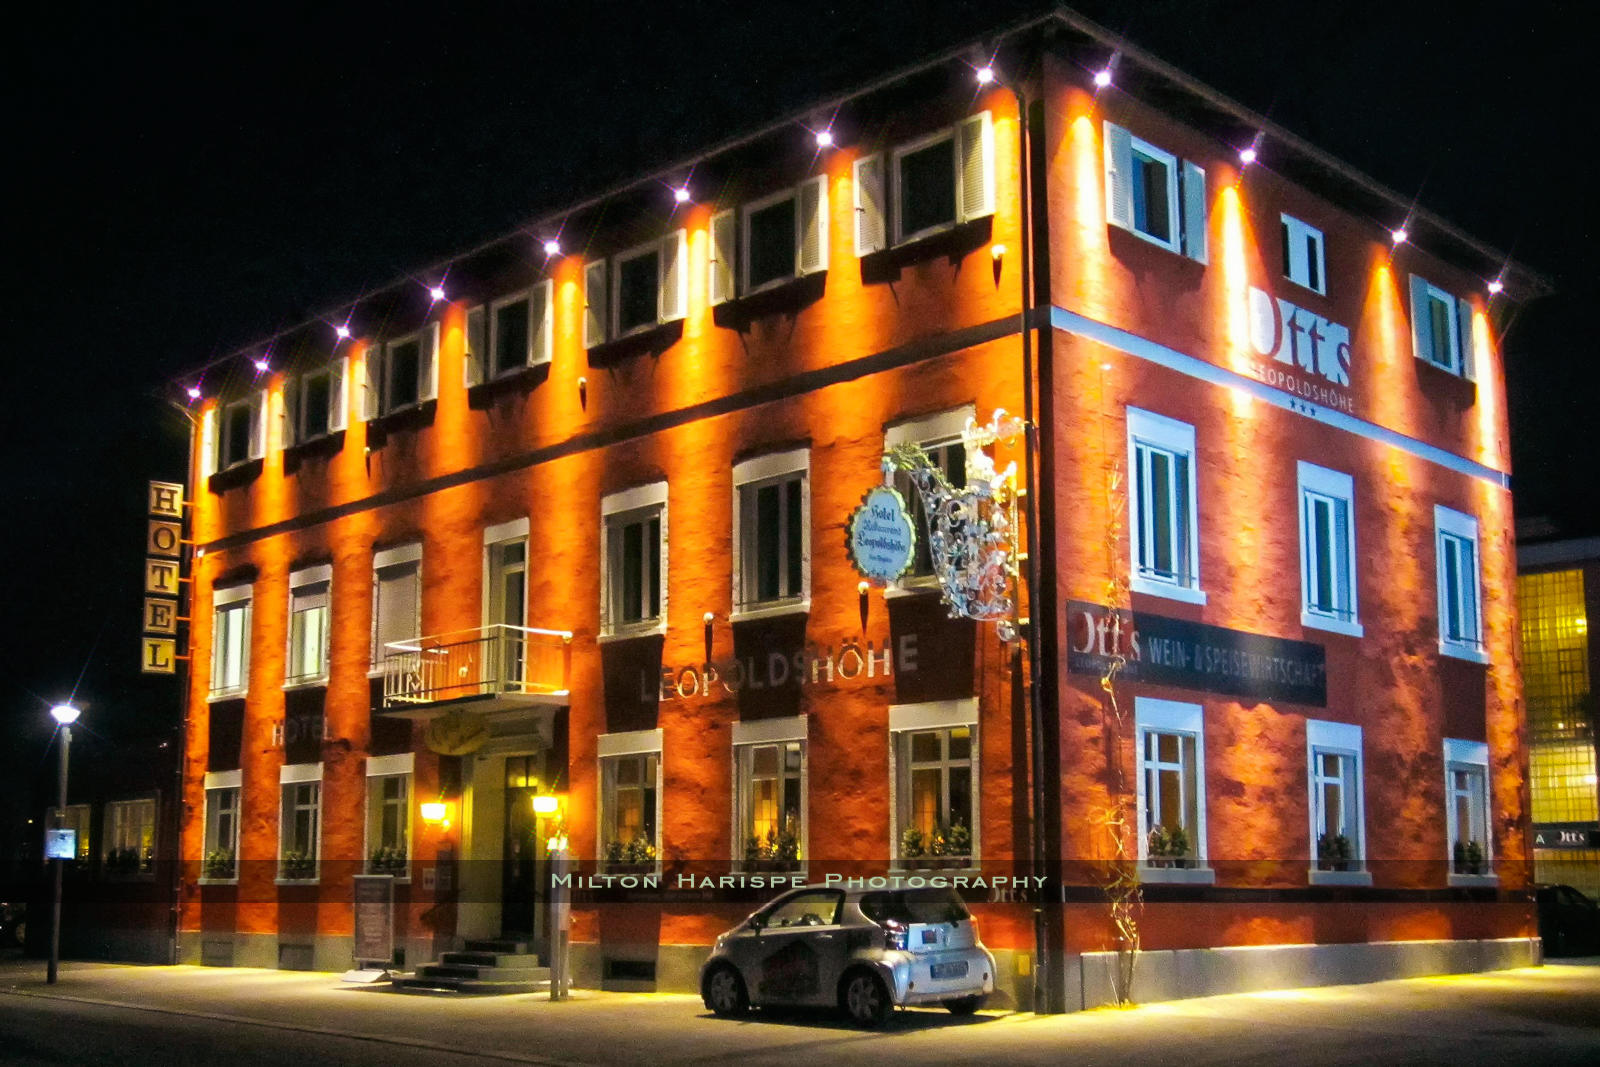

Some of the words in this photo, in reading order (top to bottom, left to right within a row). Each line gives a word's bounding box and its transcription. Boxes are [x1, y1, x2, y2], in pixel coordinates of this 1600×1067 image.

[148, 486, 181, 670] HOTEL
[639, 633, 919, 703] LEOPOLDSHÖHE
[1148, 635, 1192, 669] WEIN-
[1194, 643, 1203, 672] &
